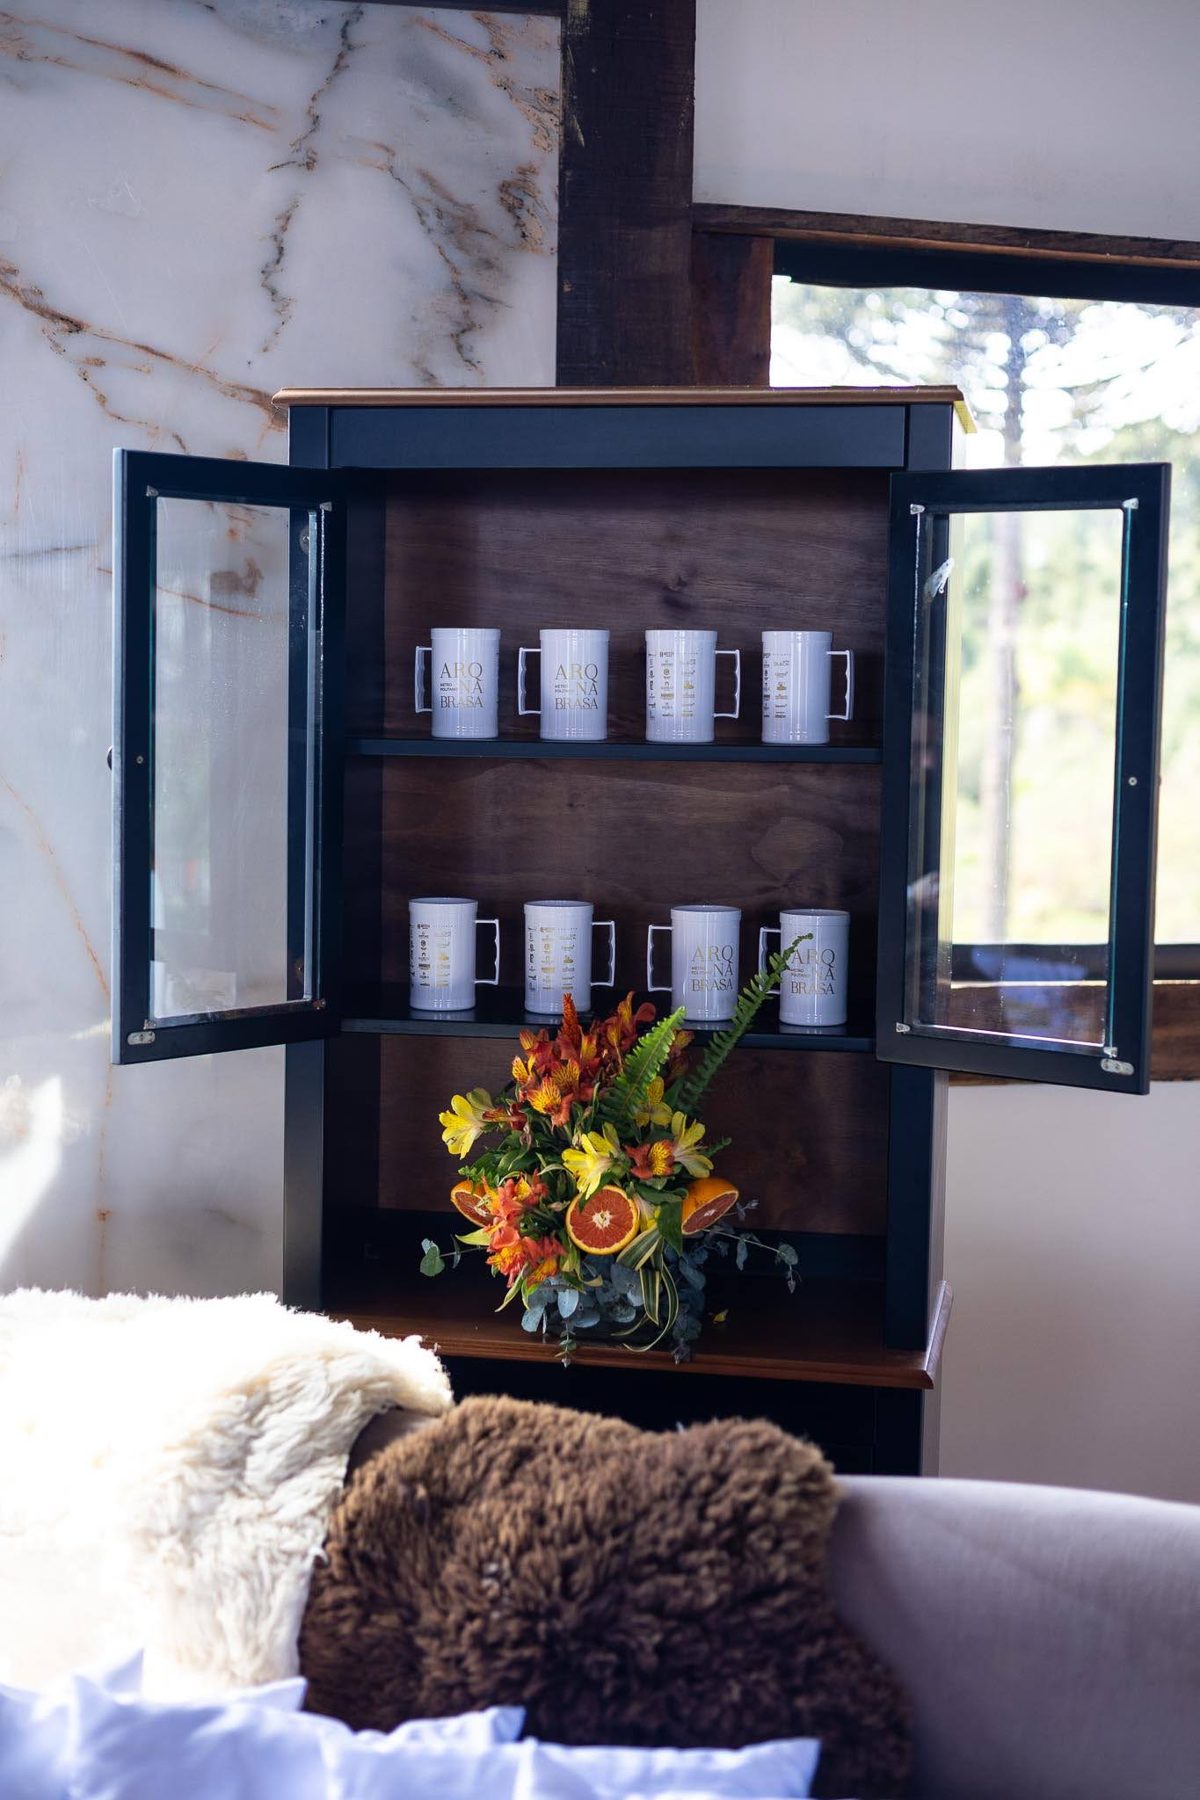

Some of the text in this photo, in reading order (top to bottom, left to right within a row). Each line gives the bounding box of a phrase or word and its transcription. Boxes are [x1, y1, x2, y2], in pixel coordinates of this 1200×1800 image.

[440, 662, 482, 681] ARQ
[555, 664, 598, 683] ARQ
[577, 682, 598, 695] NA
[440, 696, 483, 708] BRASA
[555, 698, 598, 710] BRASA
[692, 944, 733, 964] ARQ
[791, 948, 835, 968] ARQ
[714, 963, 733, 976] NA
[691, 978, 733, 991] BRASA
[791, 981, 835, 994] BRASA
